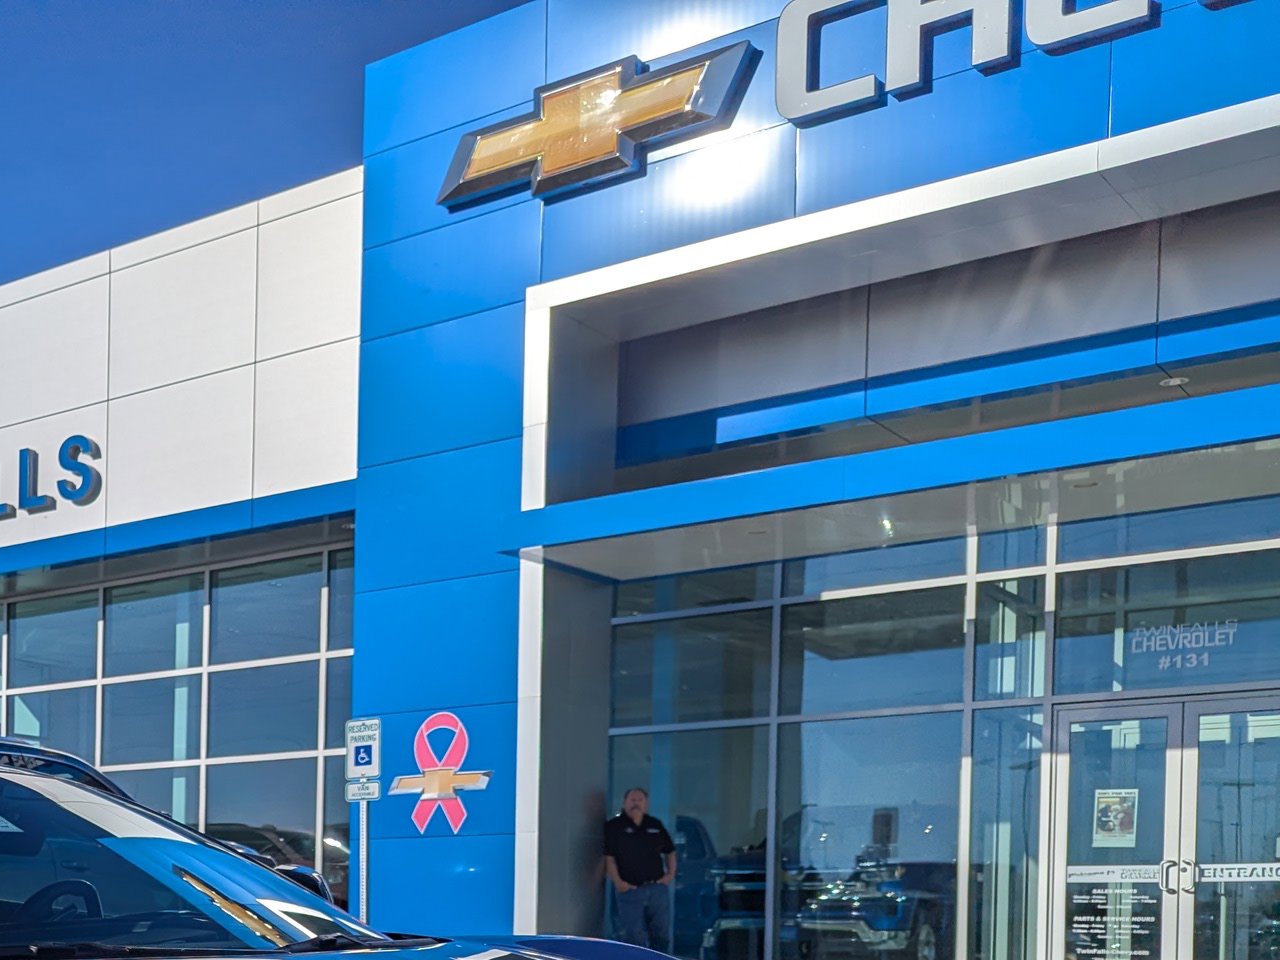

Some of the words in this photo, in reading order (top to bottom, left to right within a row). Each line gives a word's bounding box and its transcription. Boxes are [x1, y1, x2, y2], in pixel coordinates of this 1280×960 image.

[1131, 630, 1237, 654] CHEVROLET
[1158, 652, 1210, 671] #131
[349, 723, 378, 733] RESERVED
[350, 734, 377, 743] PARKING
